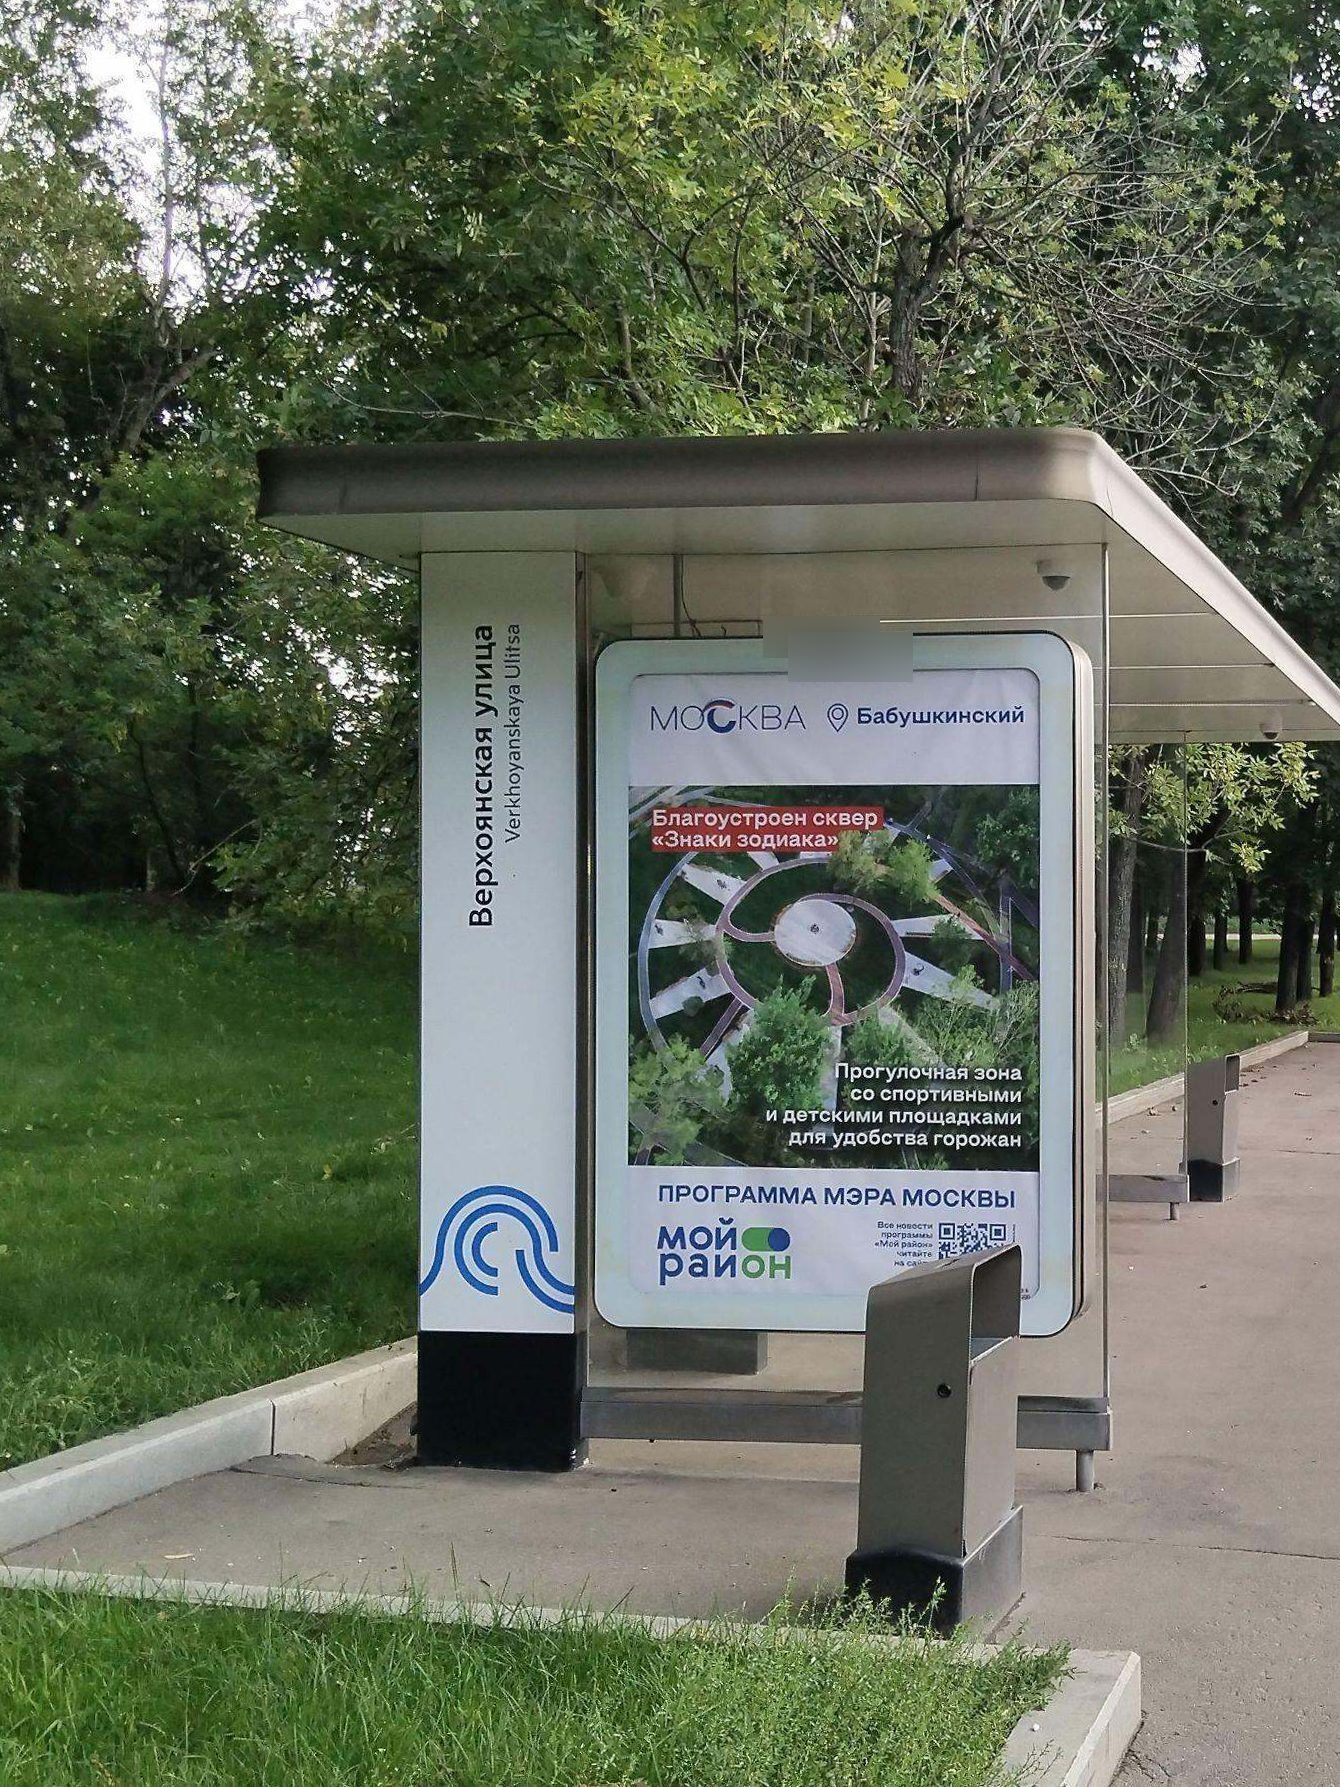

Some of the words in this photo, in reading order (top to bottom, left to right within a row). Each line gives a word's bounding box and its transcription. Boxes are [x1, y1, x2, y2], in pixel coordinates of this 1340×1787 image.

[504, 623, 521, 679] Ulitsa
[474, 624, 498, 718] улица
[650, 700, 807, 734] МОСКВА
[857, 705, 1025, 728] Бабушкинский
[504, 684, 525, 843] Verkhoyanskaya
[468, 727, 498, 927] Верхоянская
[652, 809, 807, 830] Благоустроен
[812, 812, 878, 830] сквер
[651, 830, 731, 848] «Знаки
[736, 833, 839, 850] зодиака»
[835, 1062, 968, 1083] Прогулочная
[974, 1067, 1023, 1081] зона
[850, 1088, 876, 1102] со
[880, 1088, 1022, 1105] спортивными
[766, 1109, 778, 1122] и
[782, 1109, 883, 1123] детскими
[889, 1110, 1022, 1126] площадками
[788, 1131, 826, 1147] для
[832, 1128, 928, 1149] удобства
[934, 1133, 1022, 1150] горожан
[658, 1184, 817, 1206] ПРОГРАММА
[824, 1187, 897, 1207] МЭРА
[902, 1188, 1016, 1209] МОСКВЫ
[657, 1217, 738, 1251] мой
[877, 1220, 895, 1229] Все
[881, 1232, 933, 1240] программы
